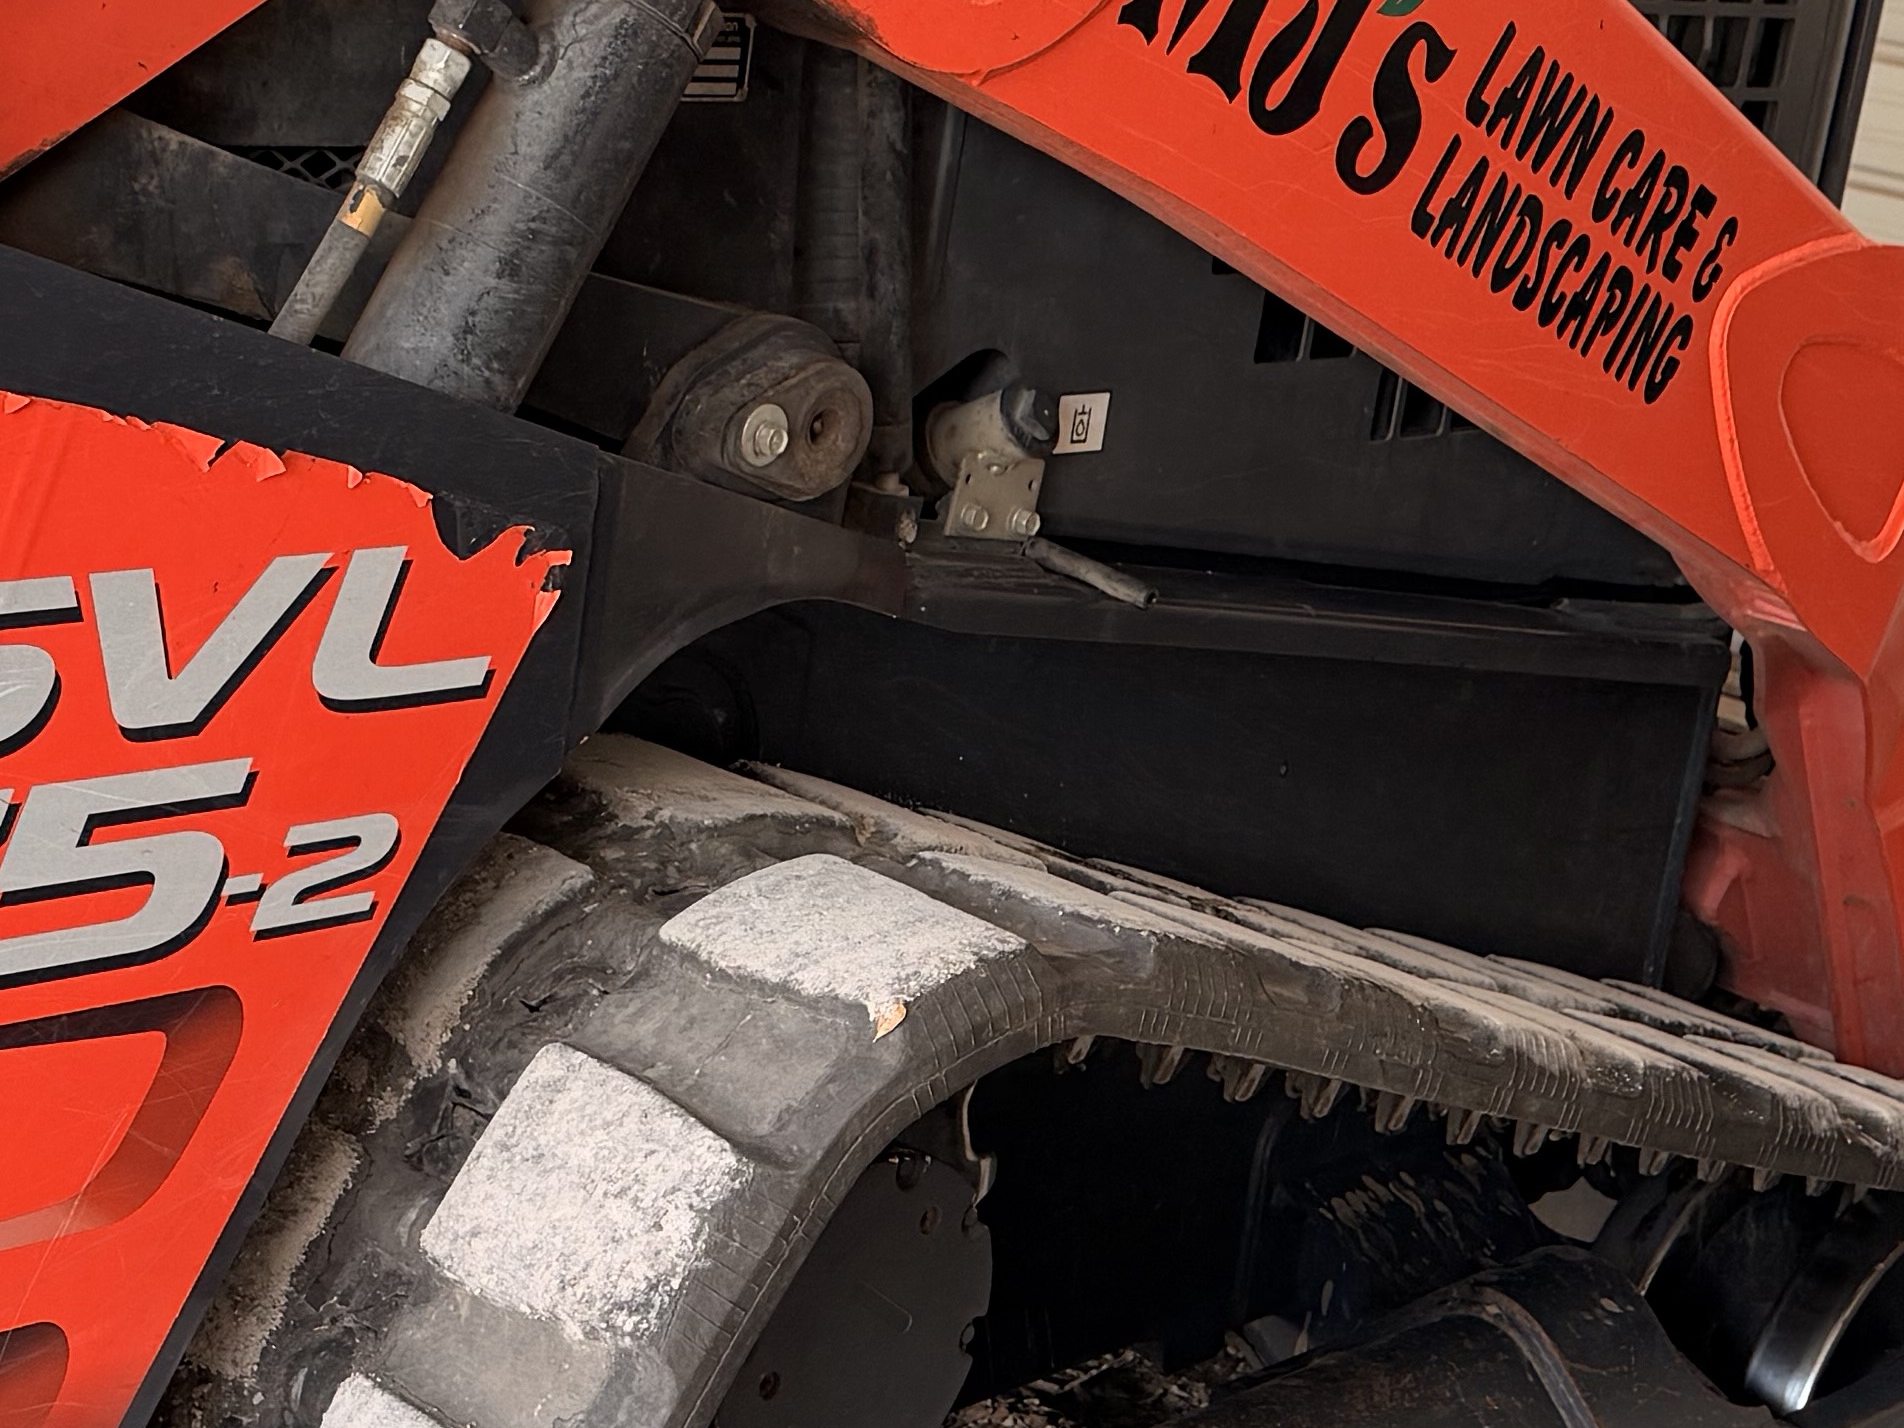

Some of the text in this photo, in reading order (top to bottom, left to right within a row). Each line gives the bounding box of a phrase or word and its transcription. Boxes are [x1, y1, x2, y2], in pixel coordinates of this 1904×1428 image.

[1410, 133, 1694, 404] LANDSCAPING
[1465, 20, 1615, 200] LAWN
[1591, 129, 1717, 285] CARE
